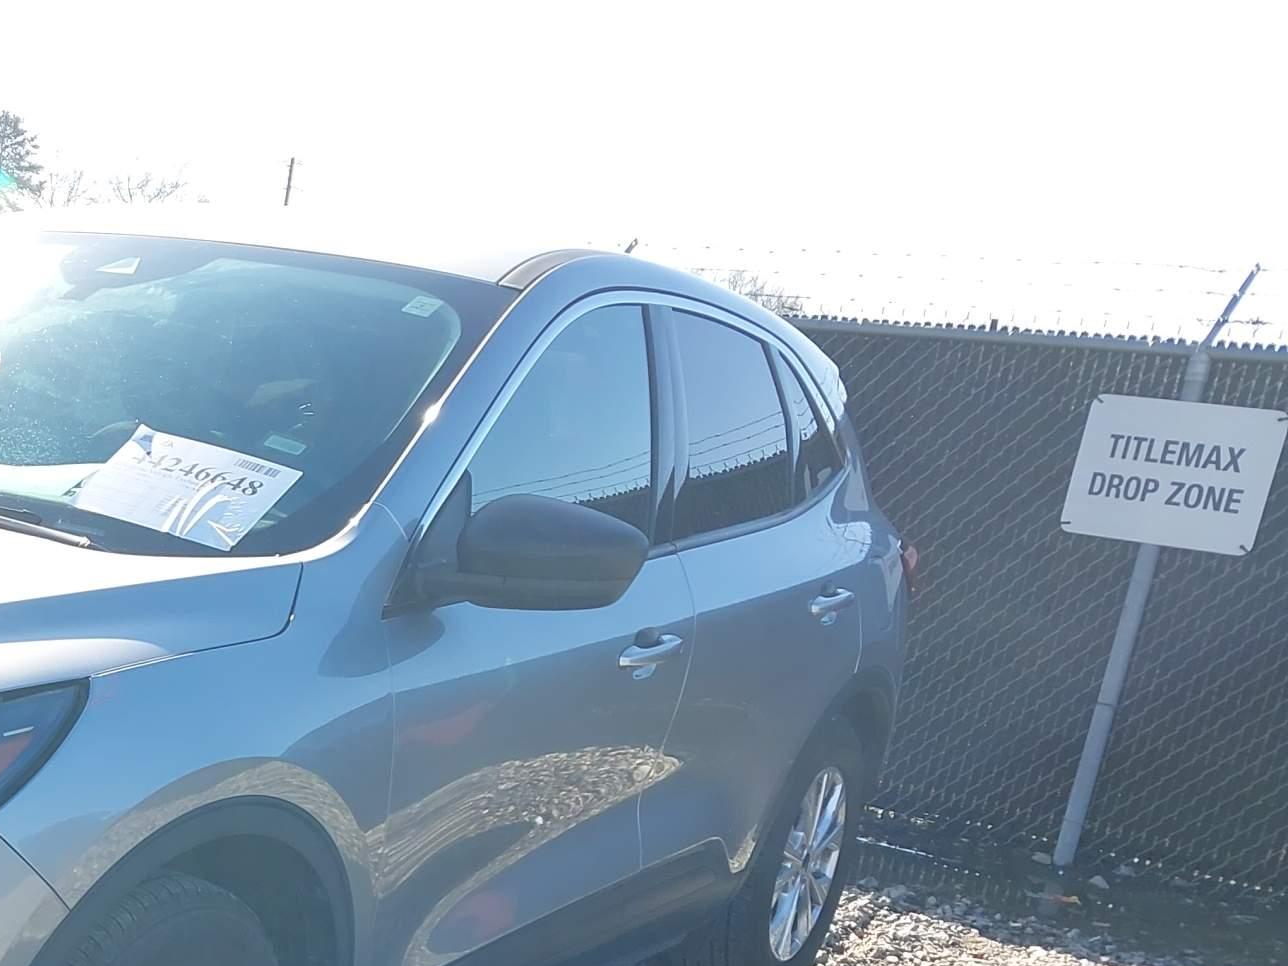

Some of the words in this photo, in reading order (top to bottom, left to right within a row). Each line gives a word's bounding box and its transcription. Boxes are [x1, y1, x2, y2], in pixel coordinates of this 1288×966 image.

[1109, 434, 1246, 473] TITLEMAX
[1087, 471, 1160, 502] DROP
[1164, 481, 1245, 514] ZONE
